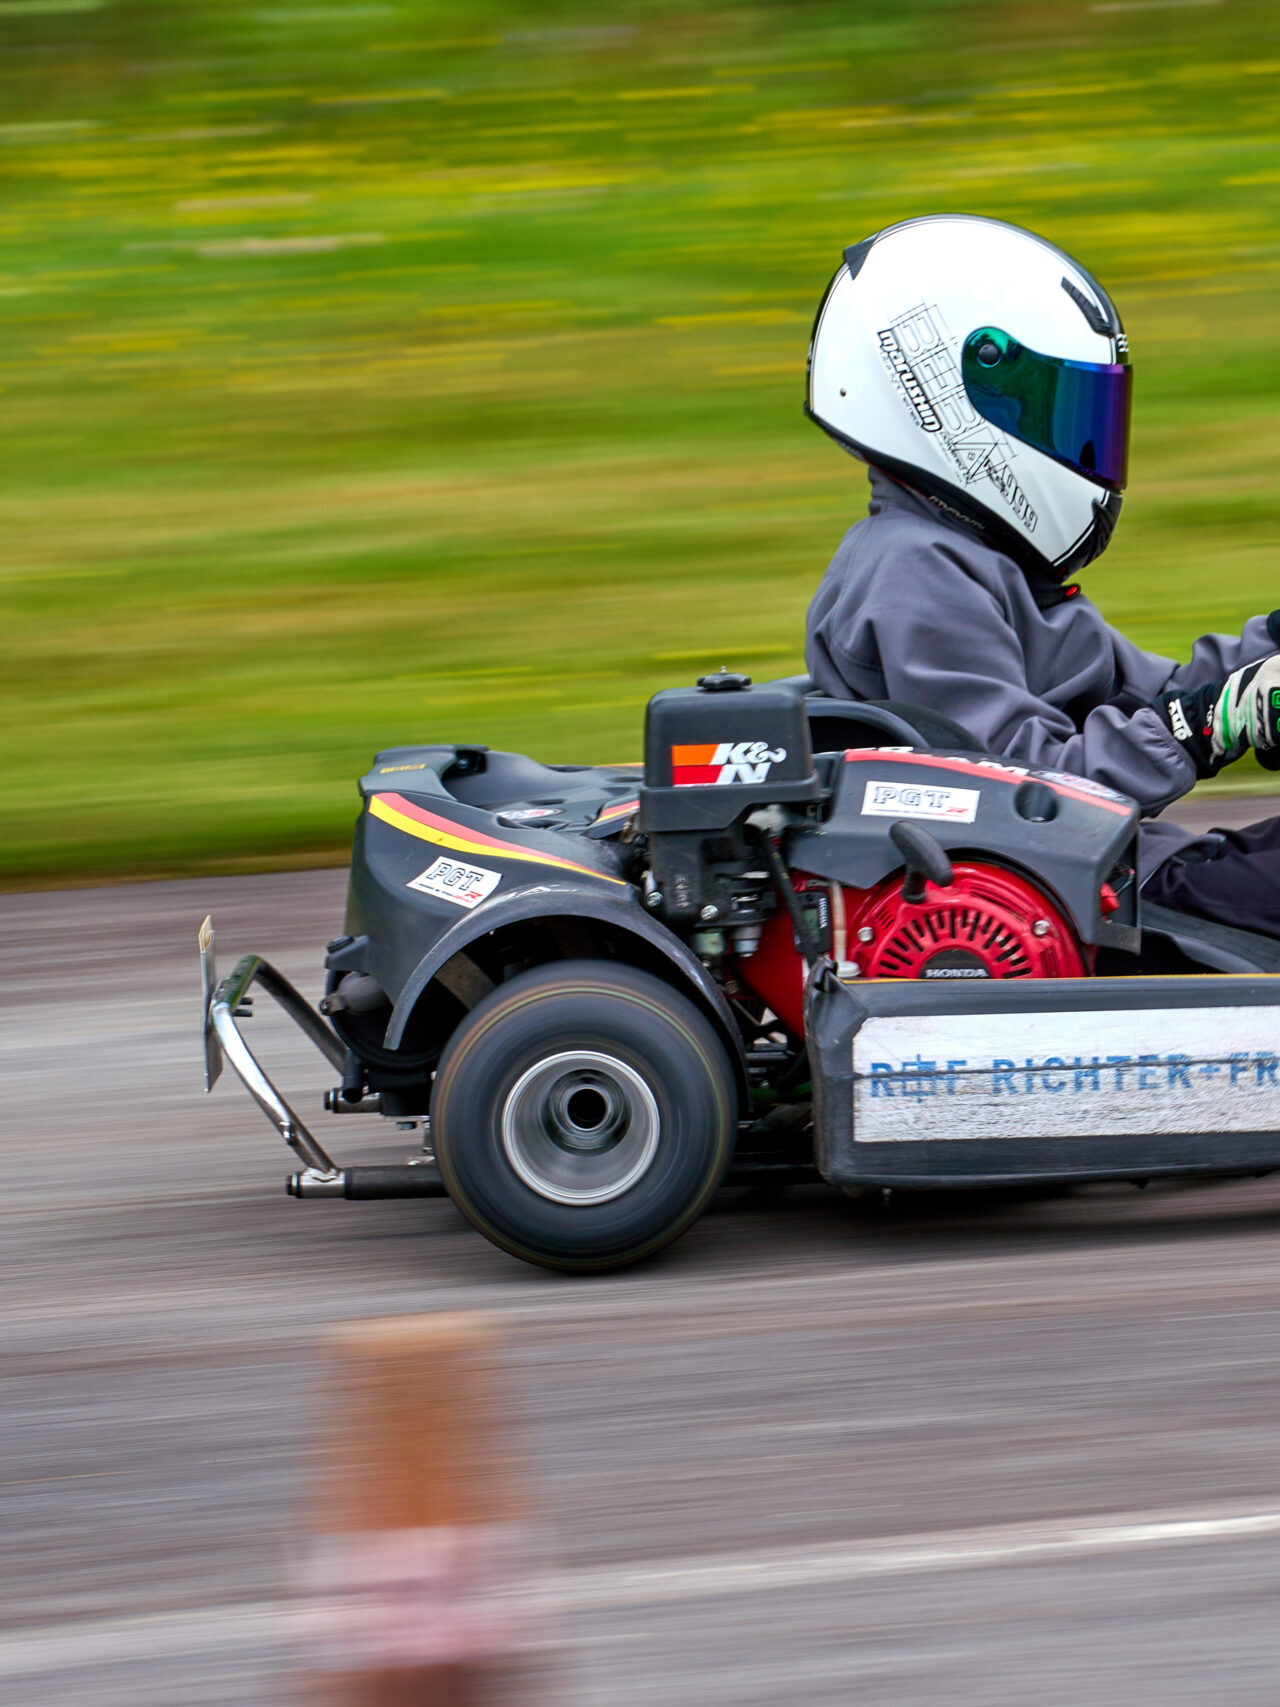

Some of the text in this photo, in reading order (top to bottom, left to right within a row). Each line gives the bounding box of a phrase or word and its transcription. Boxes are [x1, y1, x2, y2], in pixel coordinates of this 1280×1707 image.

[873, 786, 952, 809] PGT
[425, 862, 485, 892] PGT
[925, 968, 990, 978] HONDA
